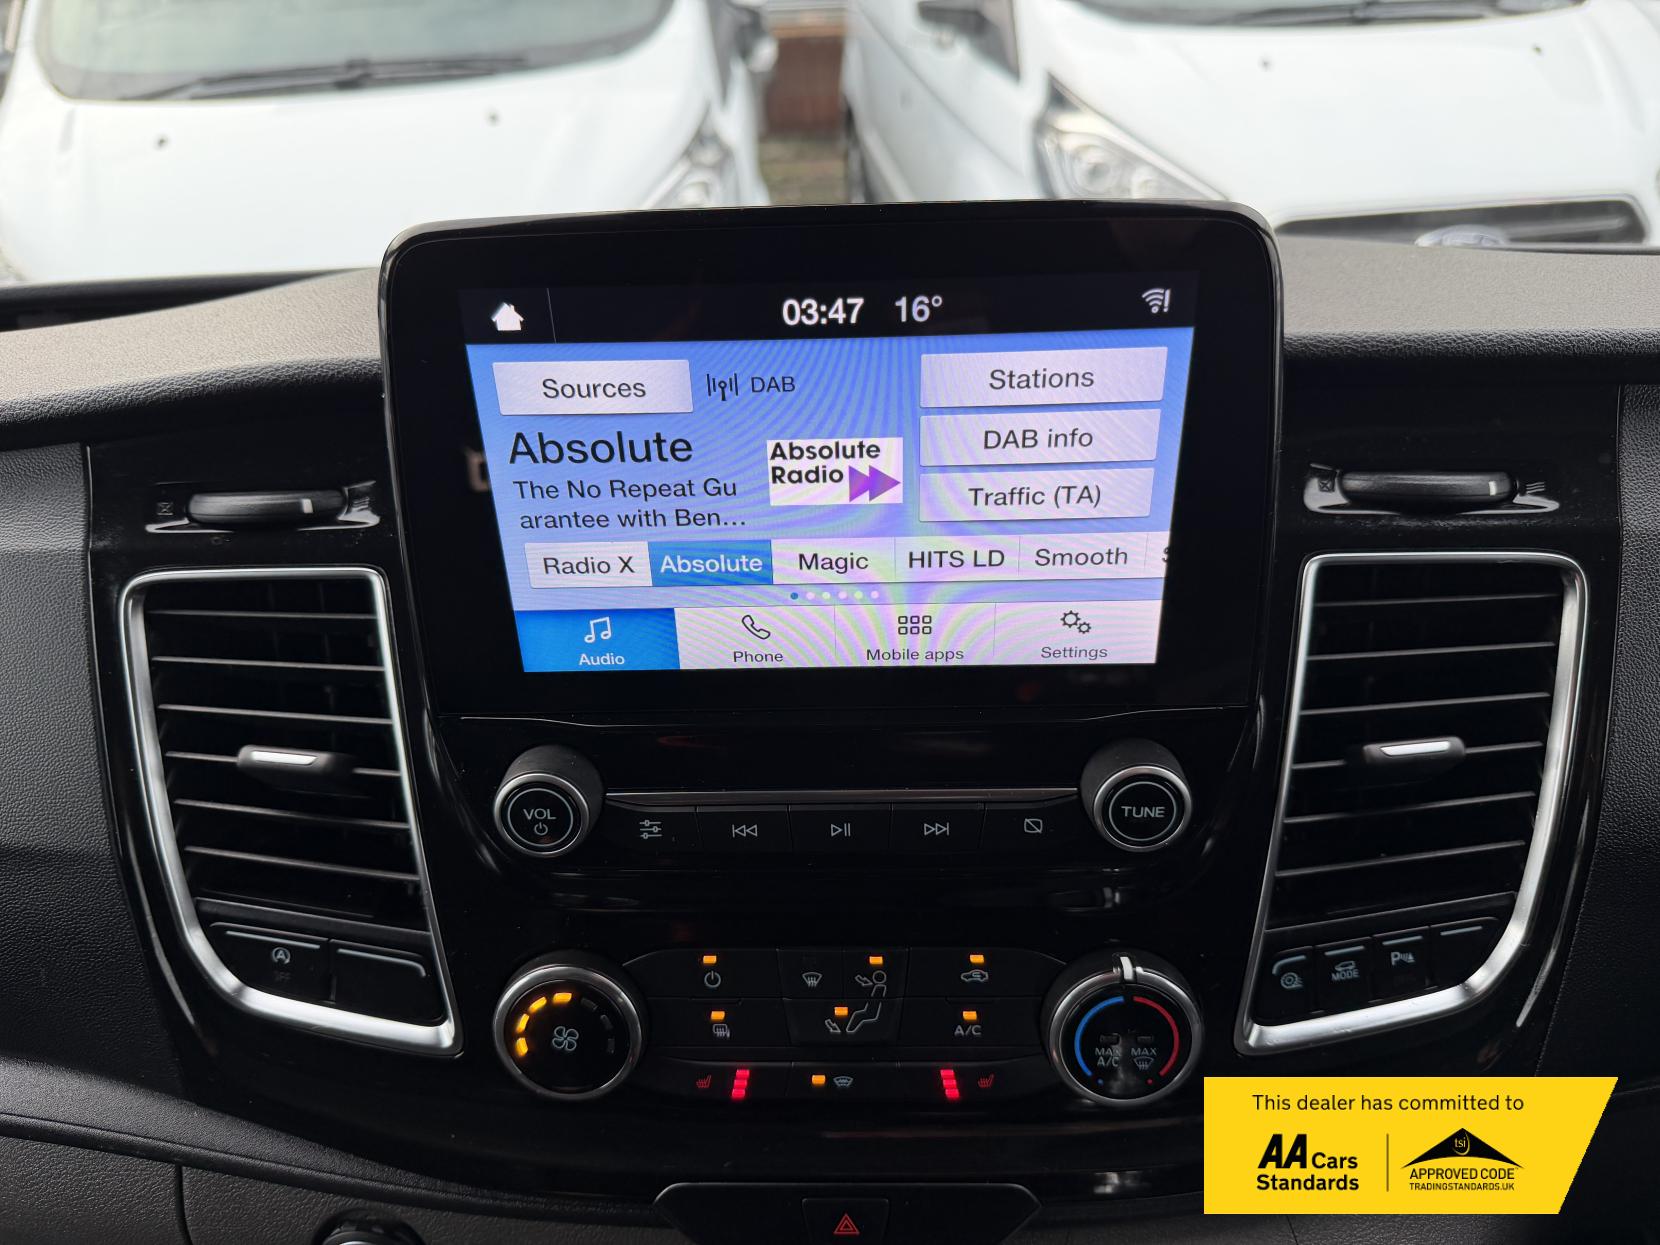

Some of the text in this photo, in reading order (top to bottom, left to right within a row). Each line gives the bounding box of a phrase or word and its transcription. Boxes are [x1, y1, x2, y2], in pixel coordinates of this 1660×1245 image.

[782, 298, 865, 326] 03:47
[895, 295, 943, 323] 16°
[541, 378, 647, 399] Sources
[751, 376, 796, 393] DAB
[988, 368, 1095, 391] Stations
[509, 431, 693, 465] Absolute
[984, 427, 1094, 450] DAB info
[769, 440, 881, 461] Absolute
[770, 464, 844, 485] Radio
[513, 478, 737, 502] The No Repeat Gu
[968, 484, 1102, 508] Traffic (TA)
[520, 511, 610, 530] arantee
[617, 508, 667, 528] with
[543, 555, 635, 576] Radio X
[660, 554, 763, 574] Absolute
[798, 552, 869, 575] Magic
[908, 549, 1006, 570] HITS LD
[1034, 547, 1128, 567] Smooth
[578, 652, 625, 666] Audio
[733, 650, 784, 663] Phone
[866, 648, 965, 662] Mobile apps
[1040, 646, 1108, 660] Settings
[523, 808, 556, 820] VOL
[1121, 805, 1167, 818] TUNE
[1331, 967, 1360, 982] MODE
[954, 1024, 982, 1037] A/C
[1095, 1047, 1121, 1057] MAX
[1097, 1056, 1119, 1068] A/C
[1131, 1047, 1157, 1057] MAX
